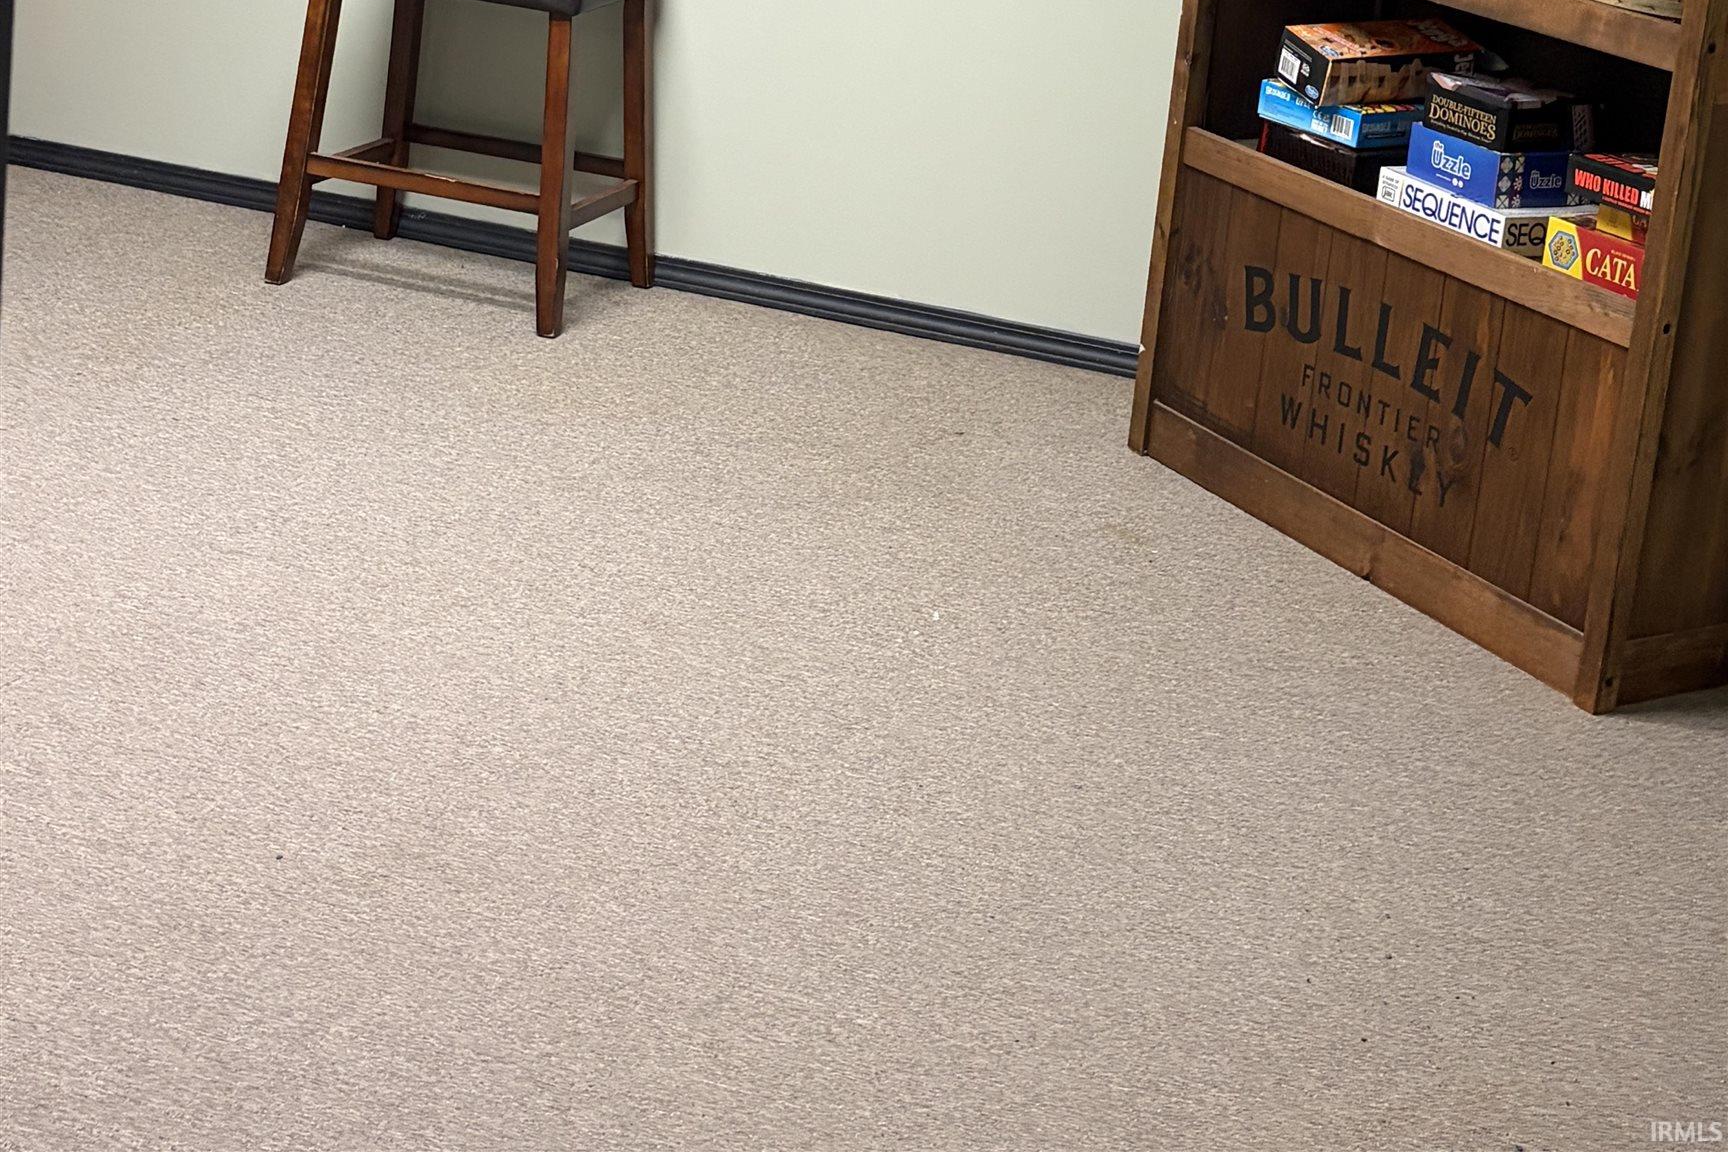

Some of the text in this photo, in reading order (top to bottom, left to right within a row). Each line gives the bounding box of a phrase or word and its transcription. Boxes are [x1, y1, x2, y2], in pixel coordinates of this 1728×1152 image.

[1429, 103, 1496, 140] DOMINOES
[1402, 184, 1501, 244] SEQUENCE
[1575, 168, 1601, 192] WHO
[1602, 179, 1639, 205] KILLED
[1585, 248, 1639, 292] CATA
[1244, 265, 1533, 447] BULLEIT
[1302, 363, 1441, 449] FRONTIER
[1280, 393, 1460, 508] WHISKEY
